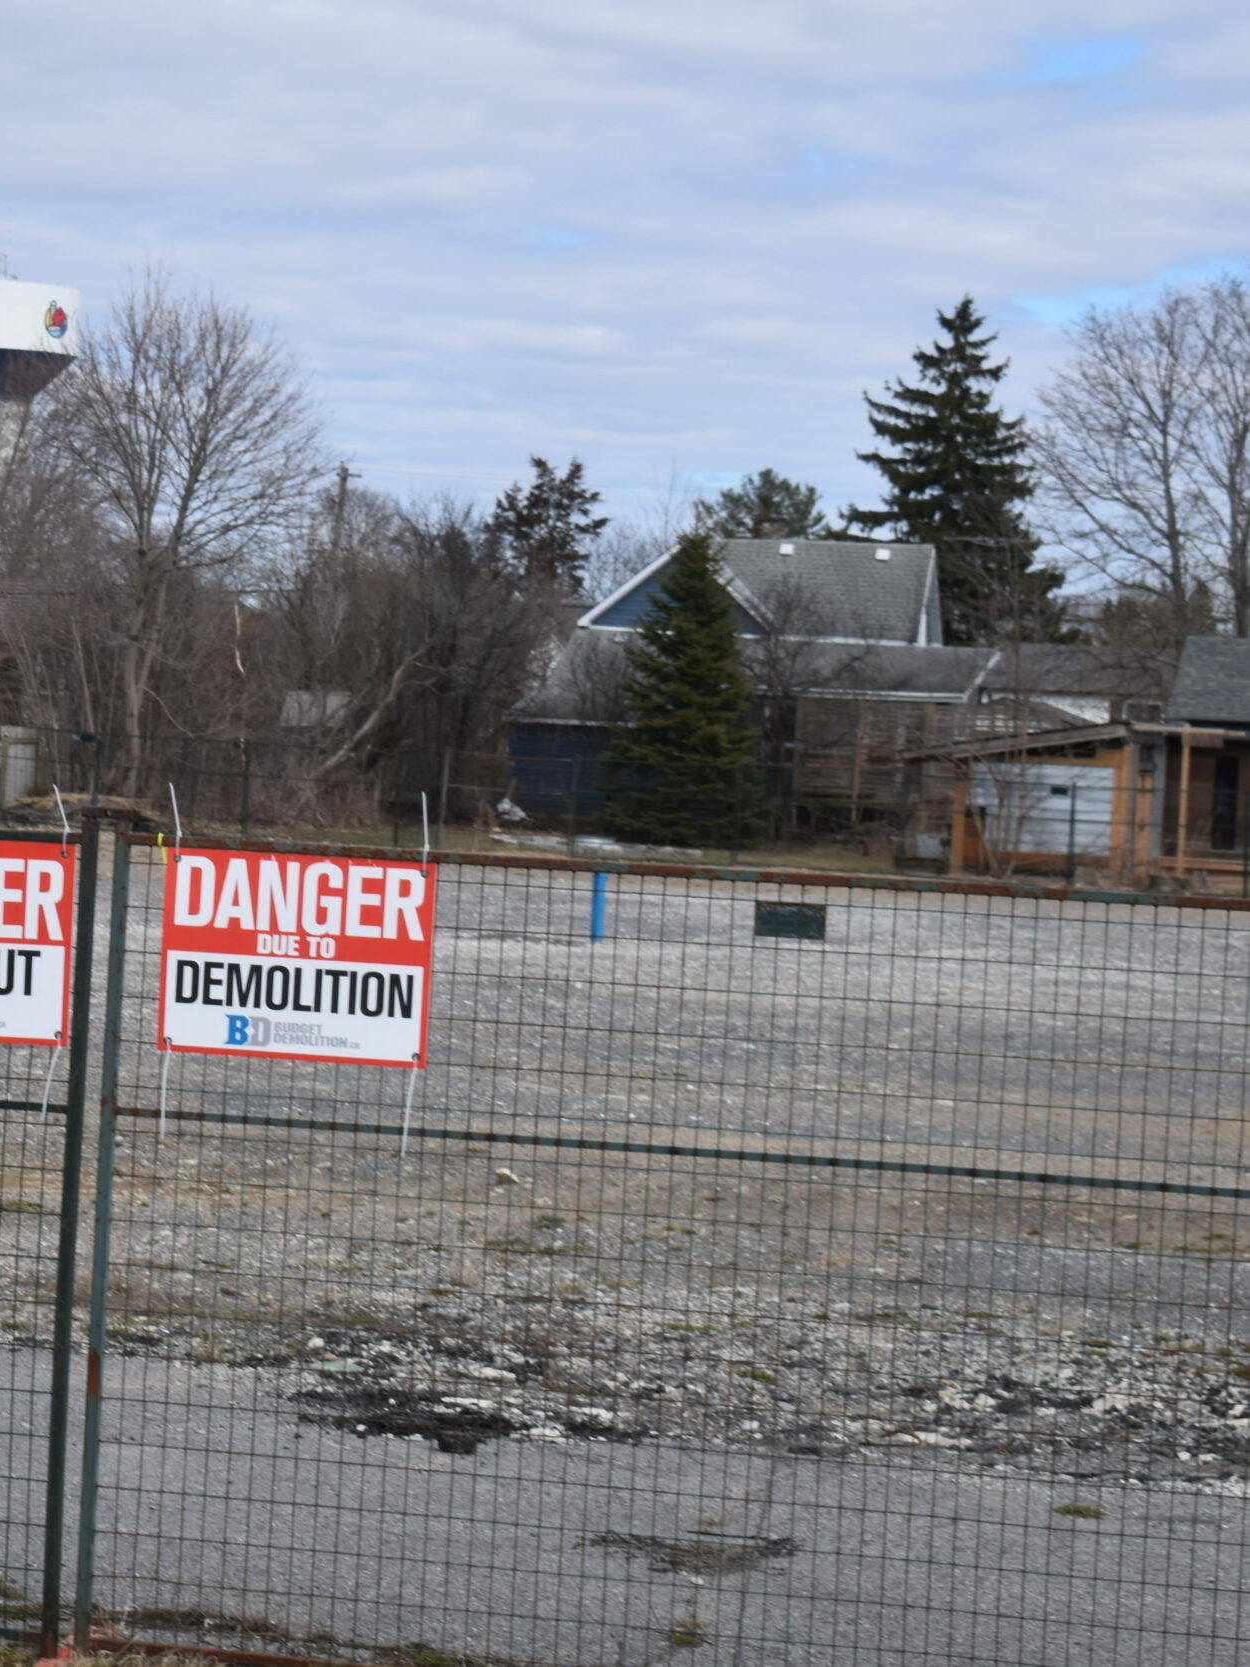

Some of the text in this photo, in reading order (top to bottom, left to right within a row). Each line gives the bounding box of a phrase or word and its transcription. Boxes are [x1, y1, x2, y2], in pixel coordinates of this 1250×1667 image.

[174, 855, 425, 941] DANGER
[257, 933, 336, 959] DUE TO
[175, 959, 414, 1018] DEMOLITION
[274, 1021, 323, 1034] BUDGET
